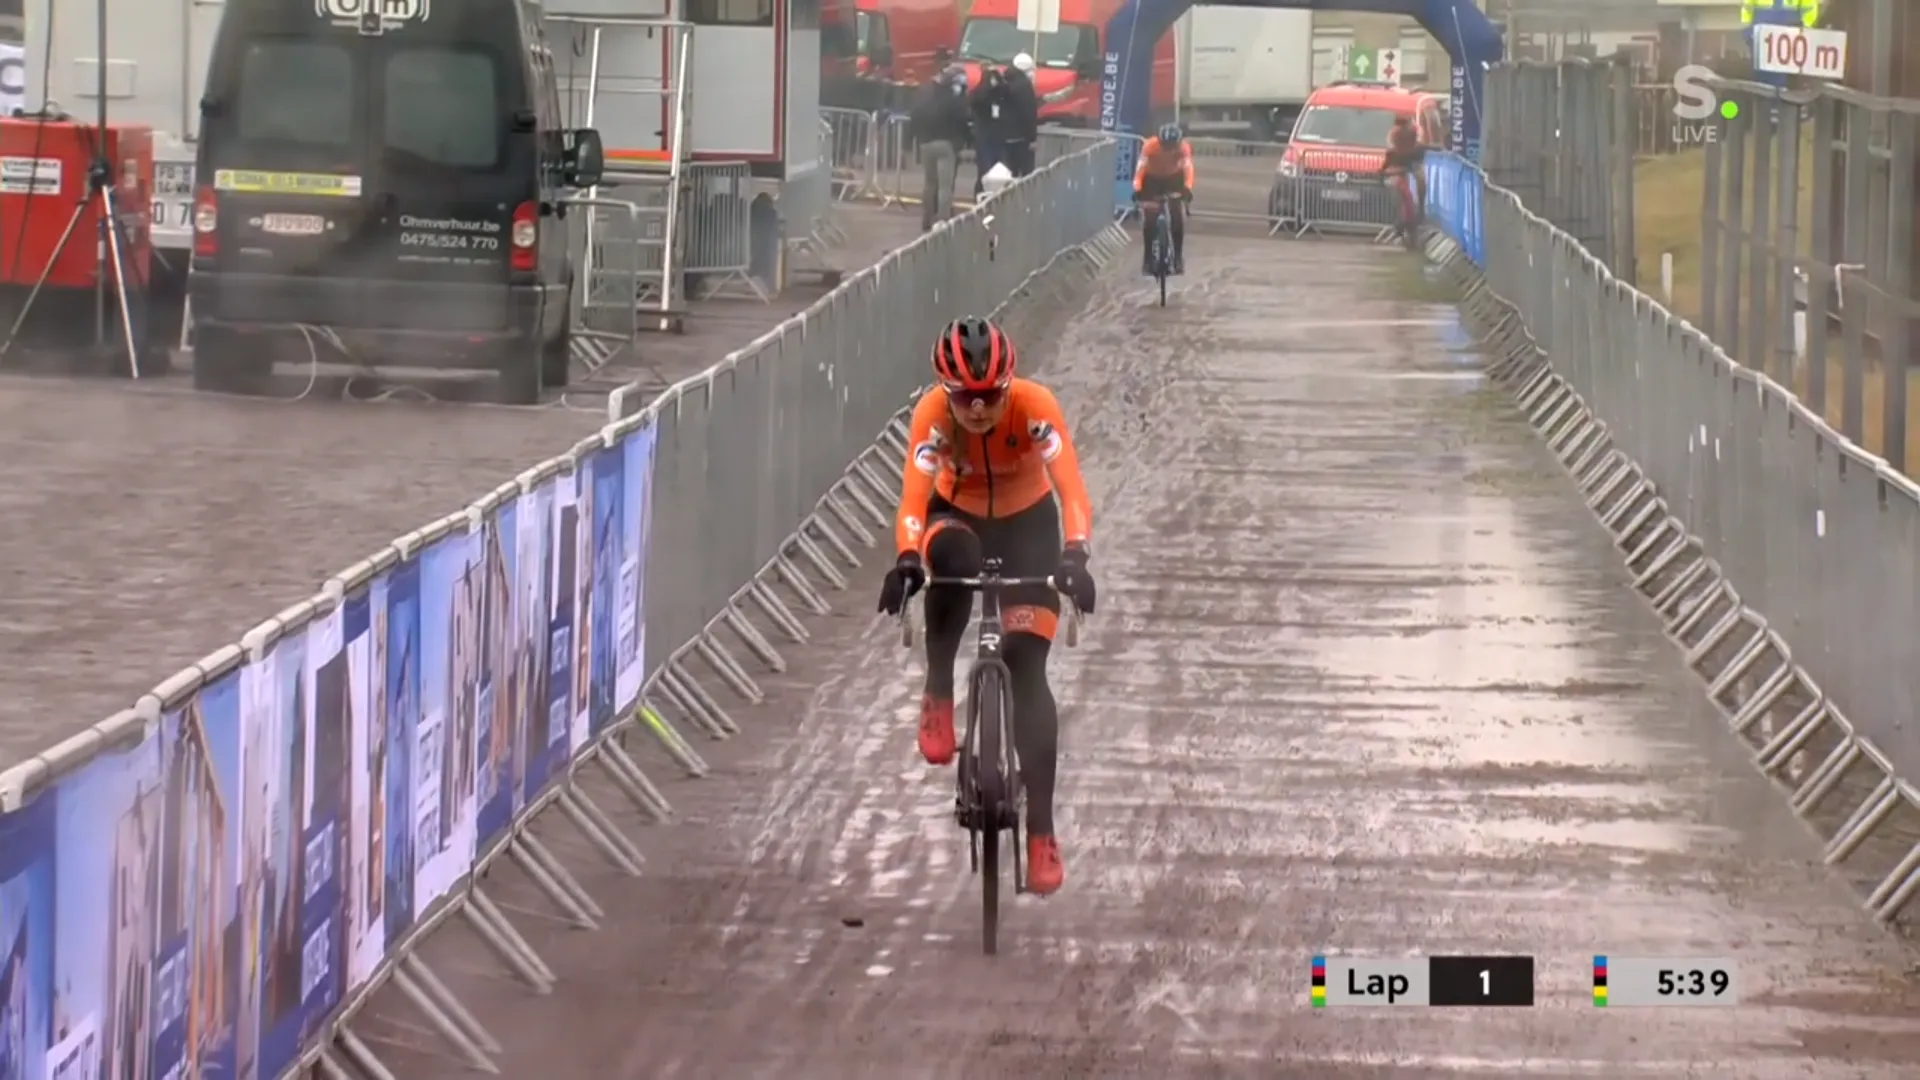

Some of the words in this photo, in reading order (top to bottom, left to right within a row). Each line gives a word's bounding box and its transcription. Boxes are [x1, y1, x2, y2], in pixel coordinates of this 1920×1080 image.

[1764, 33, 1808, 67] 100
[1815, 45, 1839, 70] m
[1101, 51, 1119, 133] ENDE.BE
[400, 214, 501, 232] Ohmverhuur.be
[400, 232, 467, 248] 0475/524
[471, 235, 499, 250] 770
